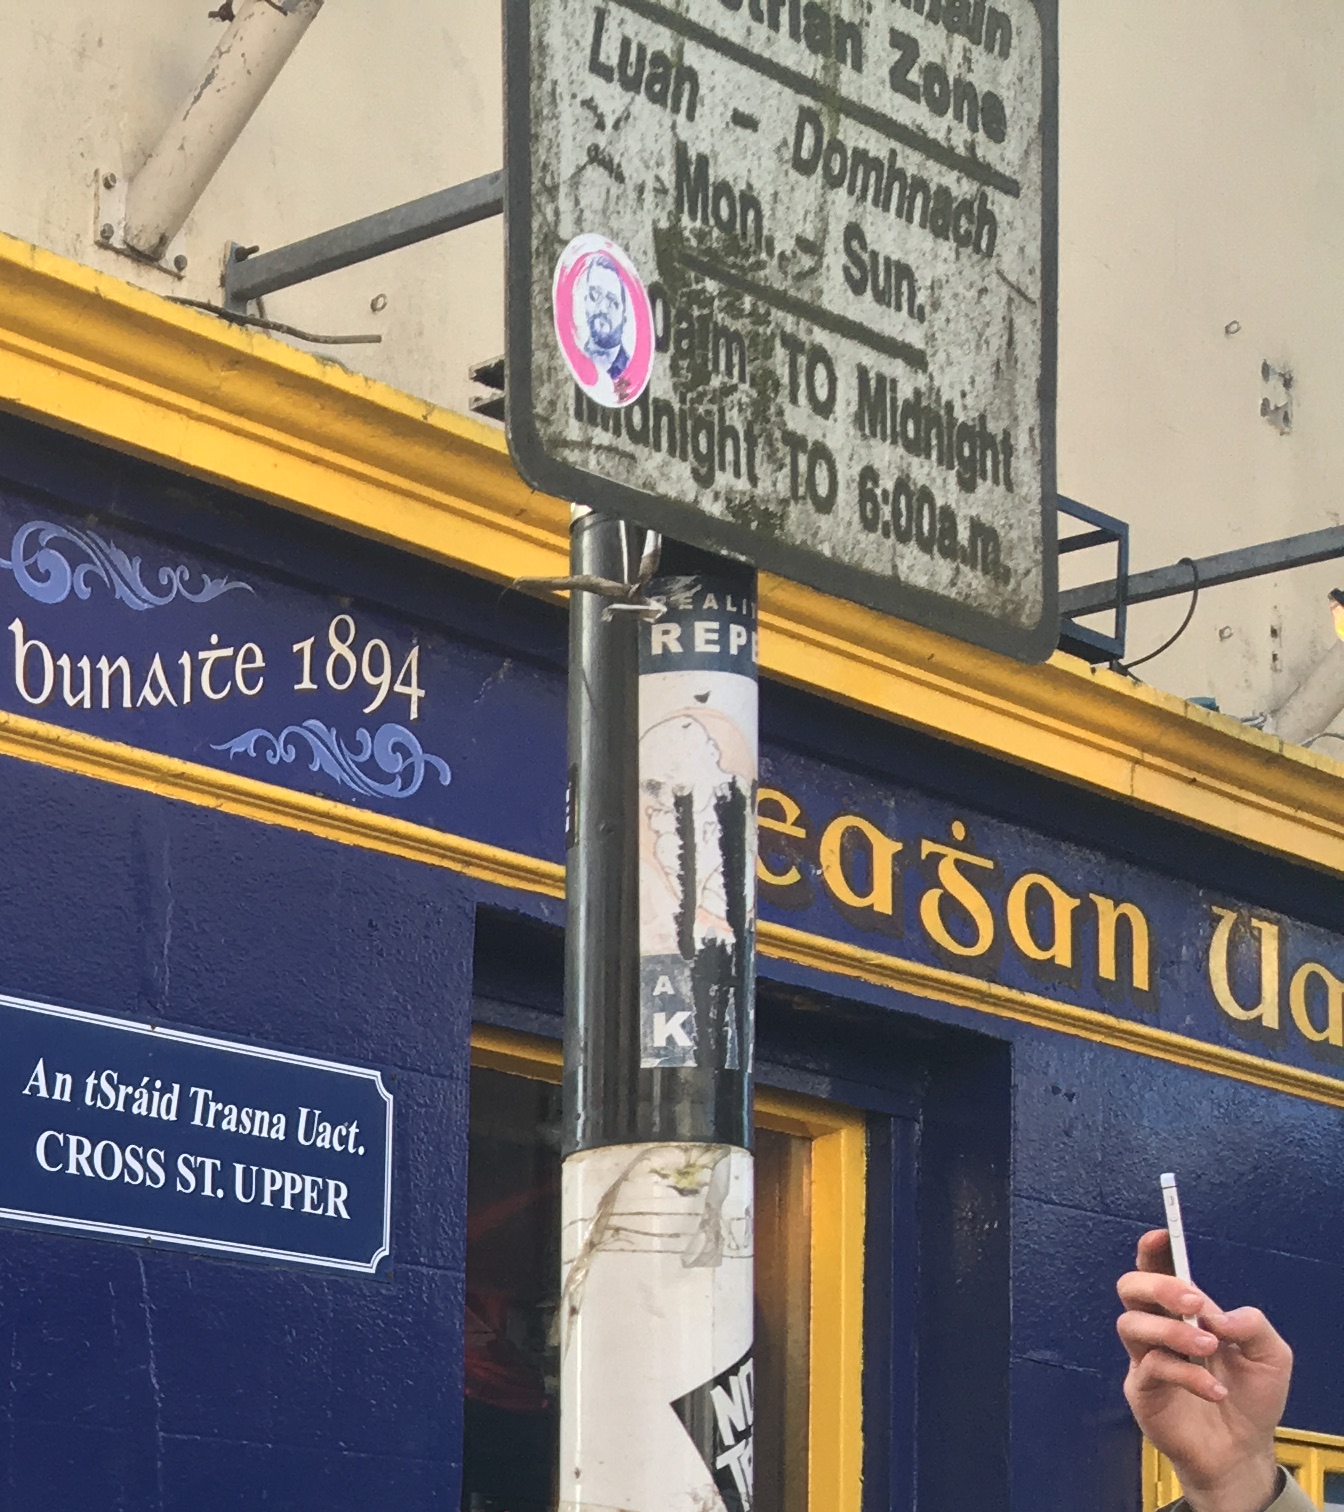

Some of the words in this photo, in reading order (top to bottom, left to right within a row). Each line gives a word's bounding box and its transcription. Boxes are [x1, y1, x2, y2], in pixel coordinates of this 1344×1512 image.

[588, 5, 700, 122] Luan
[730, 107, 759, 133] -
[791, 105, 998, 259] Domhnach
[889, 26, 1007, 144] Zone
[674, 138, 775, 259] Mon.
[841, 220, 927, 324] Sun.
[780, 329, 838, 420] TO
[856, 361, 1013, 494] Midnight
[780, 428, 839, 515] TO
[292, 613, 427, 721] 1894
[22, 1056, 72, 1103] An
[83, 1068, 180, 1123] tSráid
[188, 1086, 287, 1141] Trasna
[35, 1129, 167, 1189] CROSS
[176, 1153, 225, 1200] ST.
[232, 1162, 352, 1220] UPPER
